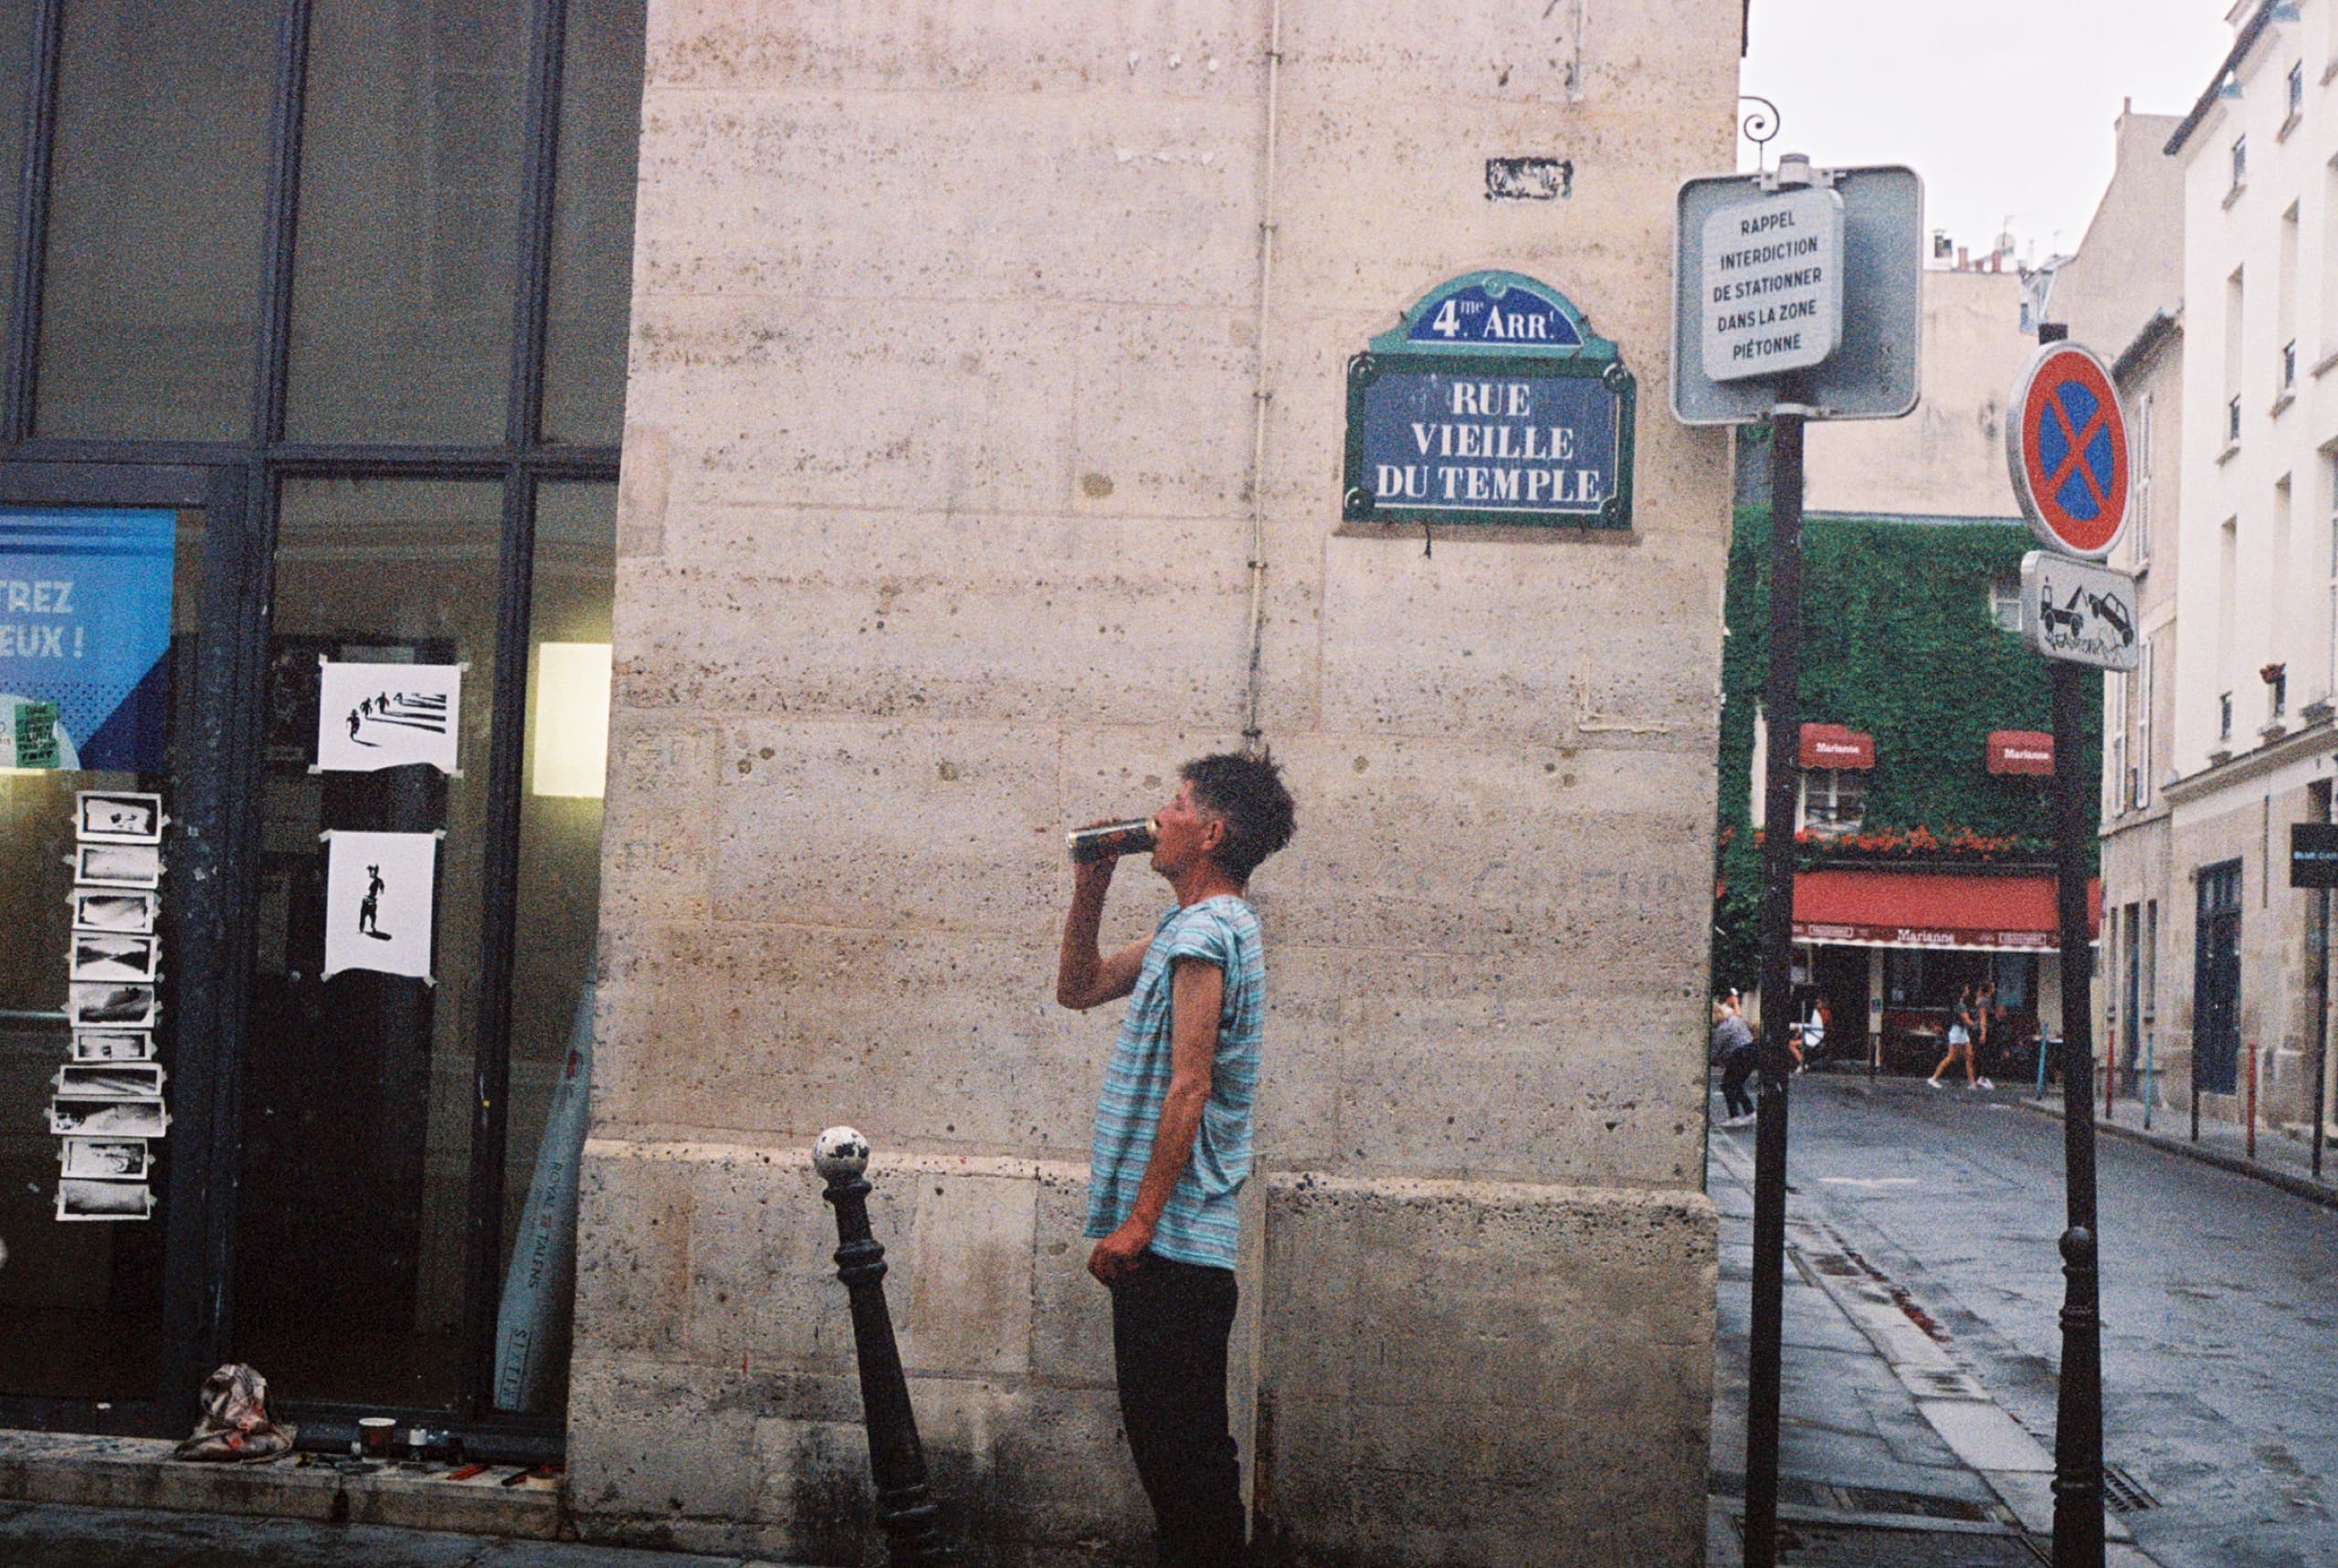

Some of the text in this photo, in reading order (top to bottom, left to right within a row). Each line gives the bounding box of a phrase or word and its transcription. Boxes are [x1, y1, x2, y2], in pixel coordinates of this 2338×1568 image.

[1741, 212, 1796, 236] RAPPEL
[1721, 236, 1817, 270] INTERDICTION
[1714, 267, 1822, 302] DE STATIONNER
[1718, 300, 1817, 332] DANS LA ZONE
[1733, 333, 1802, 361] PIÉTONNE
[1453, 383, 1531, 416] RUE
[1412, 423, 1574, 460] VIEILLE
[1375, 465, 1600, 502] DU TEMPLE
[1816, 742, 1859, 753] Marianne
[2004, 748, 2049, 760] Marianne
[1898, 929, 1954, 944] Marianne
[527, 1233, 550, 1290] TALENS
